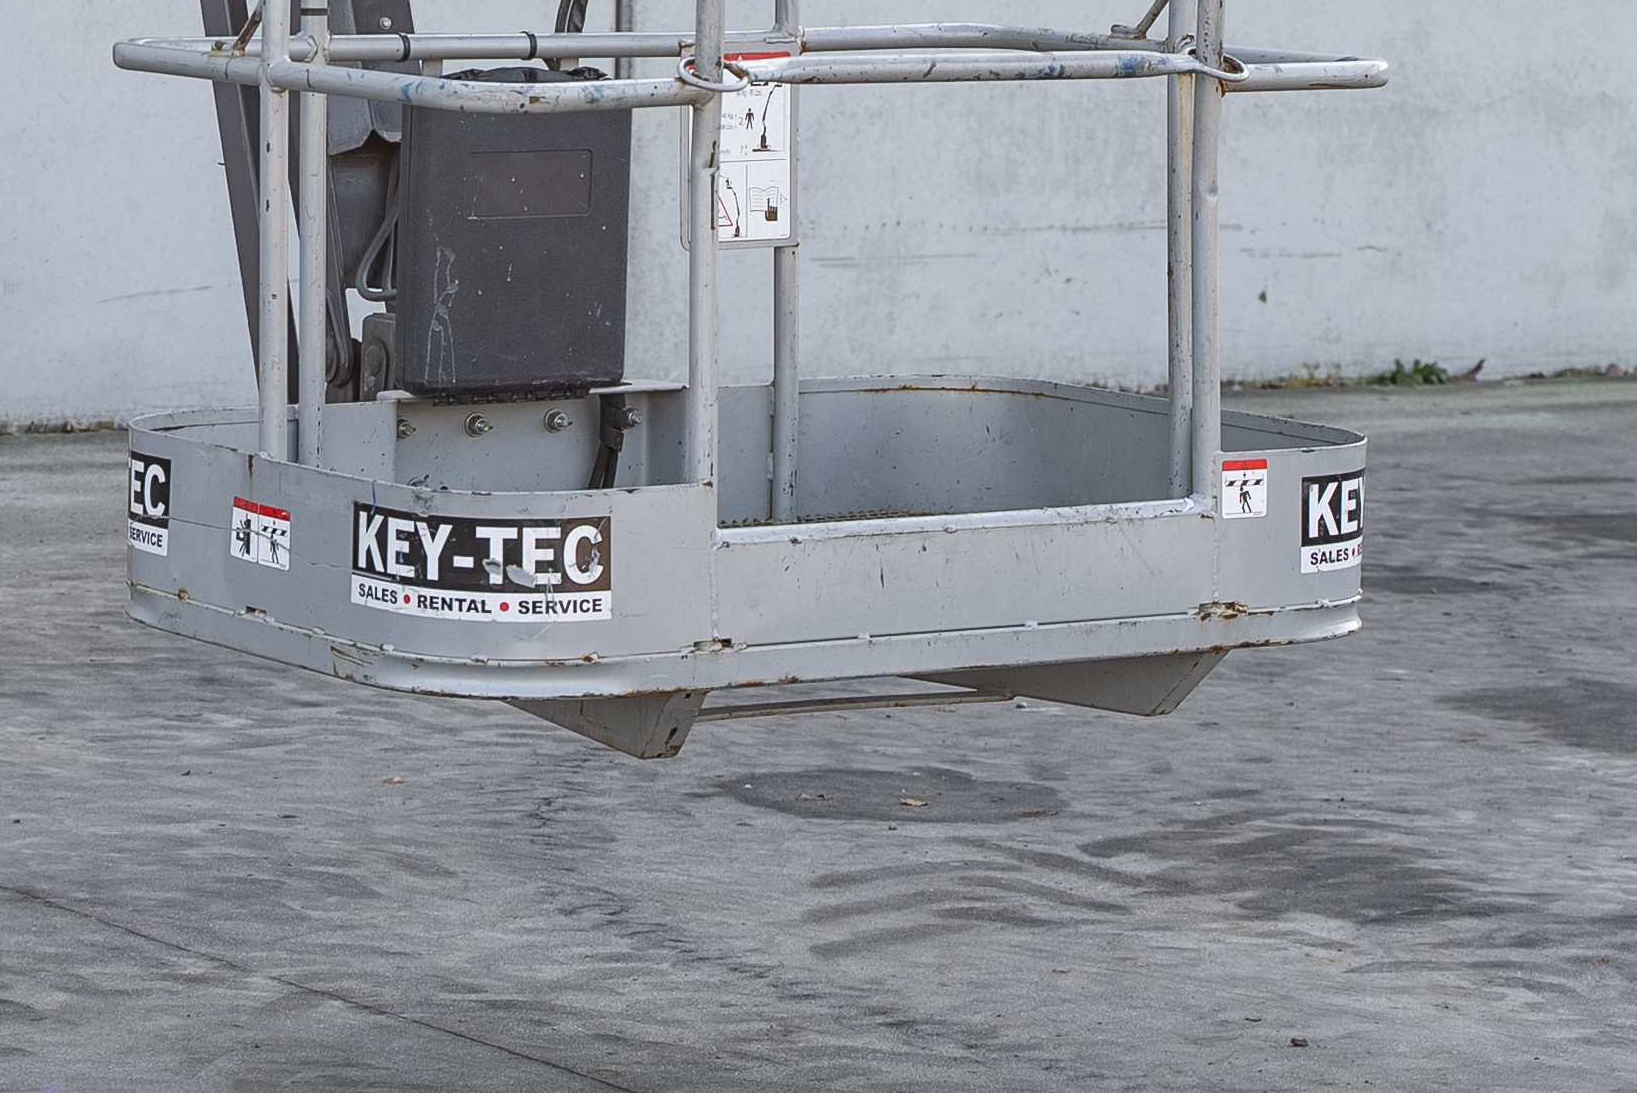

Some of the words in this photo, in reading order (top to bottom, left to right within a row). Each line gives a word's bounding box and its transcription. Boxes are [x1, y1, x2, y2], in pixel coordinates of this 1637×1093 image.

[128, 457, 166, 516] EC
[357, 511, 605, 585] KEY-TEC
[1310, 547, 1349, 566] SALES
[358, 583, 398, 605] SALES
[417, 594, 493, 614] RENTAL
[518, 598, 603, 615] SERVICE
